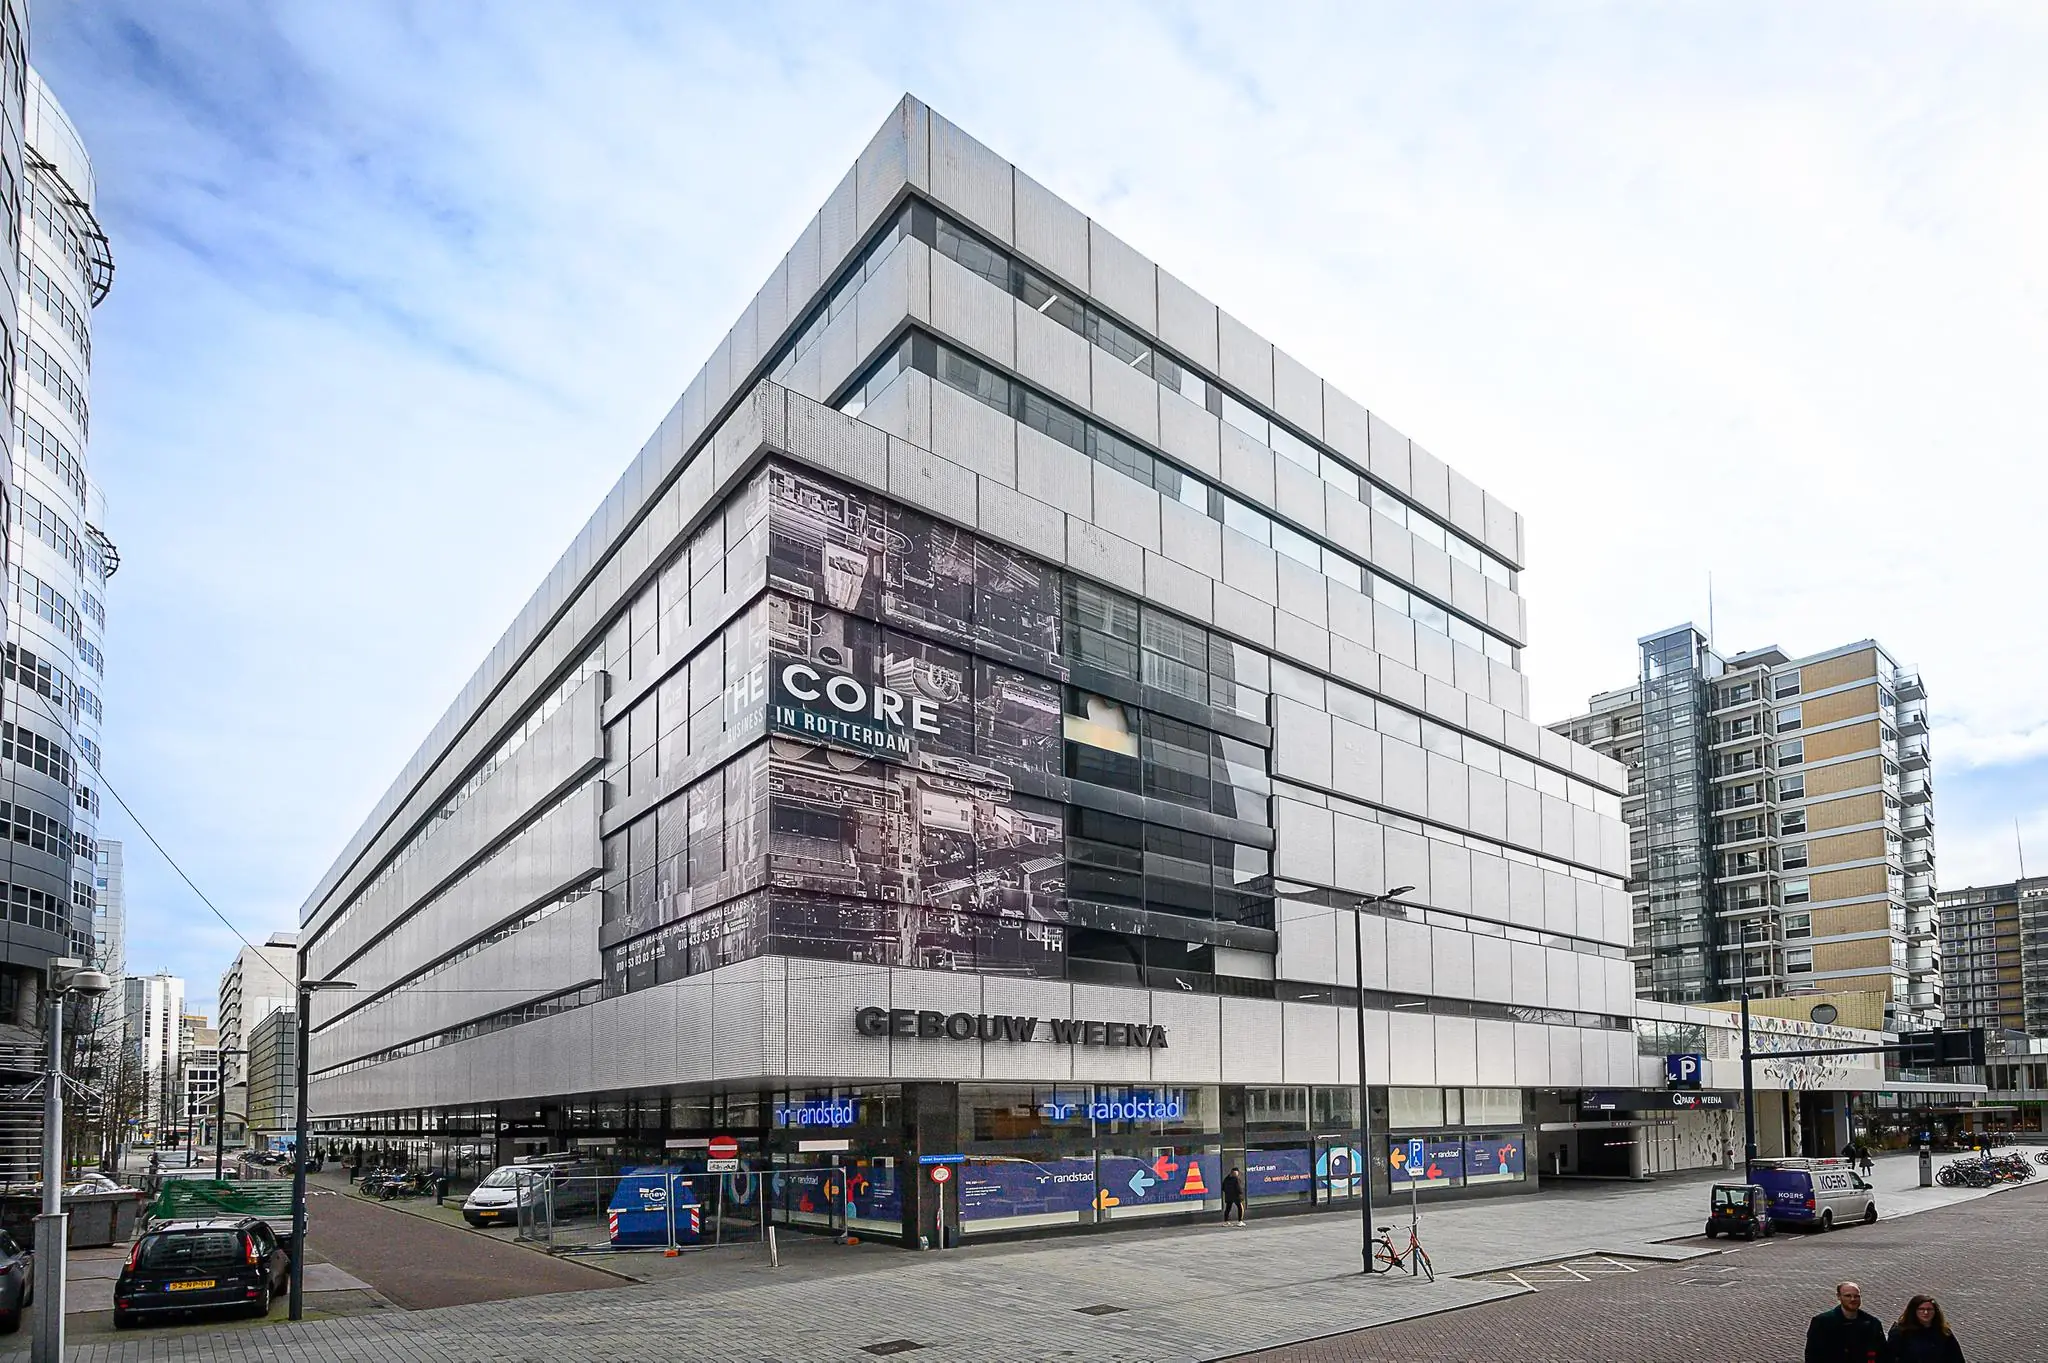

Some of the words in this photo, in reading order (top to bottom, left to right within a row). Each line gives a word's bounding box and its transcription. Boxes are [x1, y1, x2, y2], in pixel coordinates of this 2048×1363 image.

[723, 664, 764, 722] THE
[782, 663, 941, 735] CORE
[727, 706, 765, 743] BUSINESS
[776, 706, 795, 726] IN
[804, 712, 910, 754] ROTTERDAM
[701, 929, 710, 942] 35
[711, 926, 720, 939] 55
[1041, 938, 1063, 952] TH
[855, 1006, 1038, 1042] GEBOUW
[1050, 1017, 1169, 1048] WEENA
[1680, 1060, 1696, 1081] P
[1089, 1096, 1180, 1119] randstad
[1701, 1096, 1722, 1104] WEENA
[797, 1100, 852, 1124] randstad
[1413, 1142, 1421, 1157] P
[1438, 1150, 1459, 1158] randstad
[798, 1176, 819, 1184] randstad
[1053, 1171, 1094, 1183] randstad
[1818, 1174, 1848, 1191] KOERS
